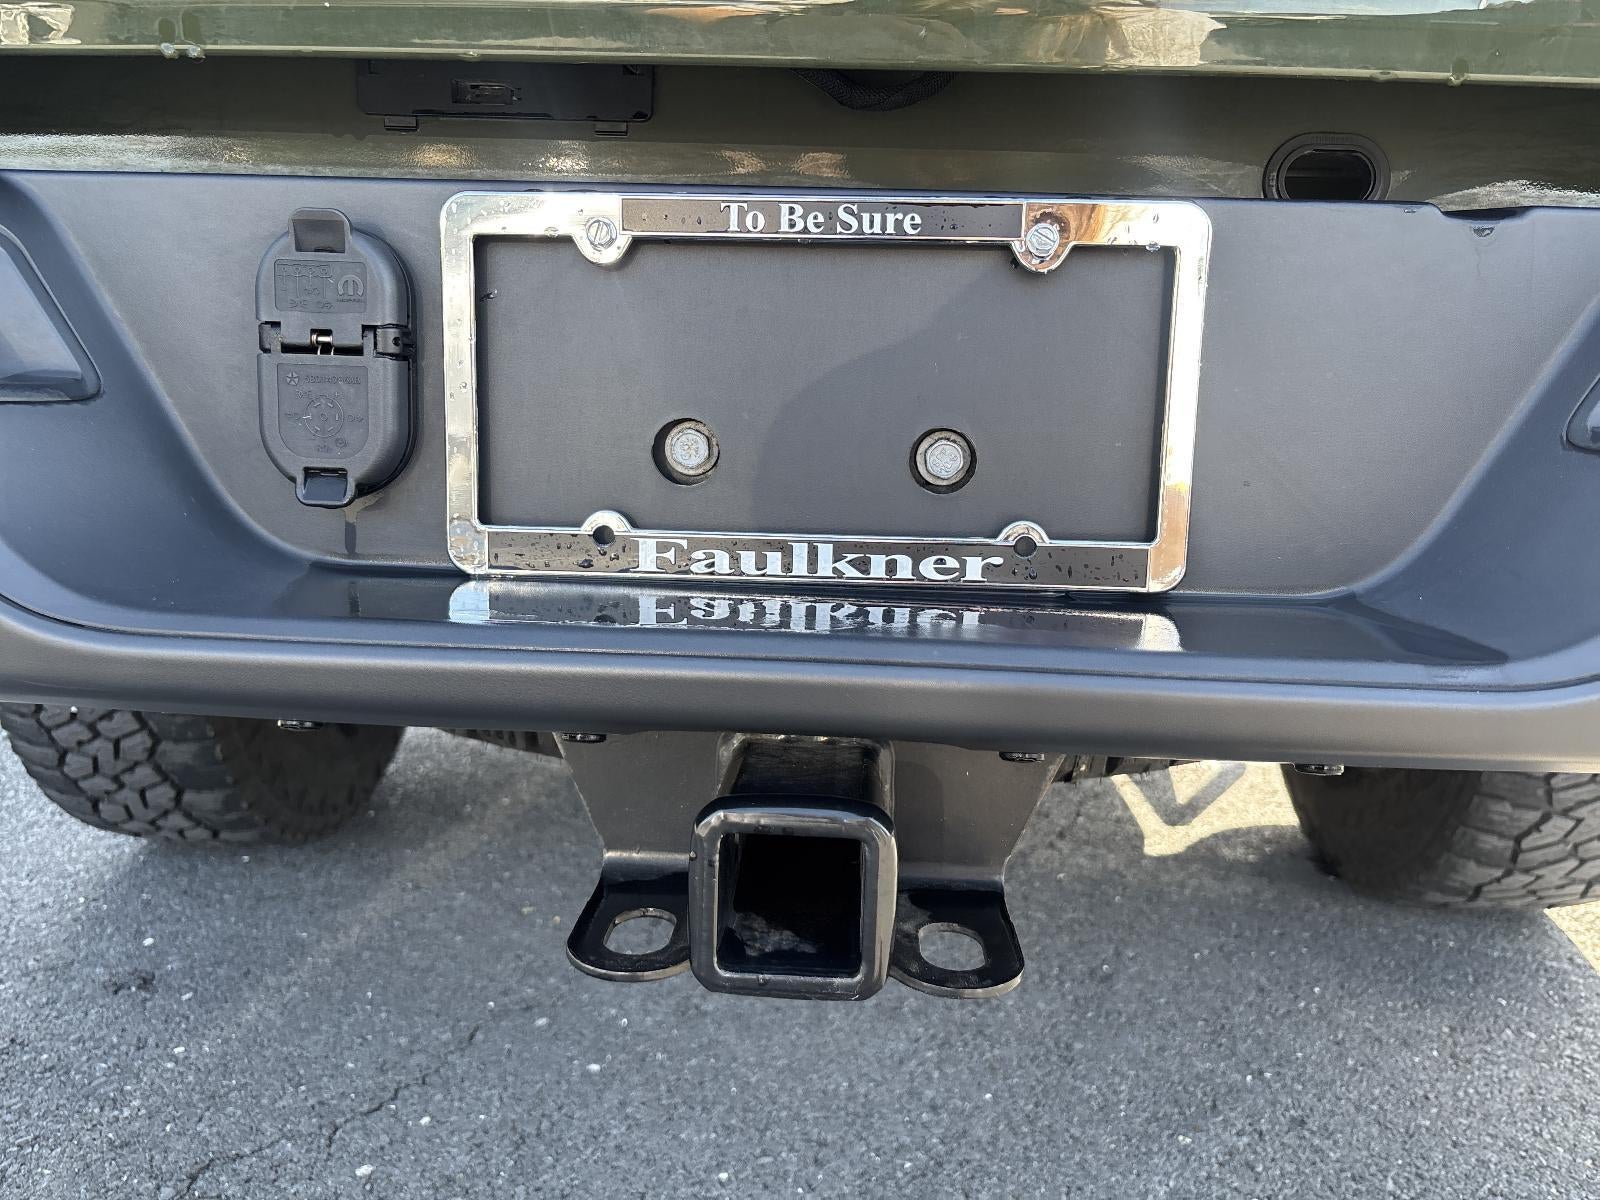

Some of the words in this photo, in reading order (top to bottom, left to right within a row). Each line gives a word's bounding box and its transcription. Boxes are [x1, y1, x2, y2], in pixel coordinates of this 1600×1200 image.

[720, 202, 766, 232] To
[778, 203, 825, 233] Be
[836, 203, 923, 235] Sure
[632, 538, 1004, 582] Faulkner
